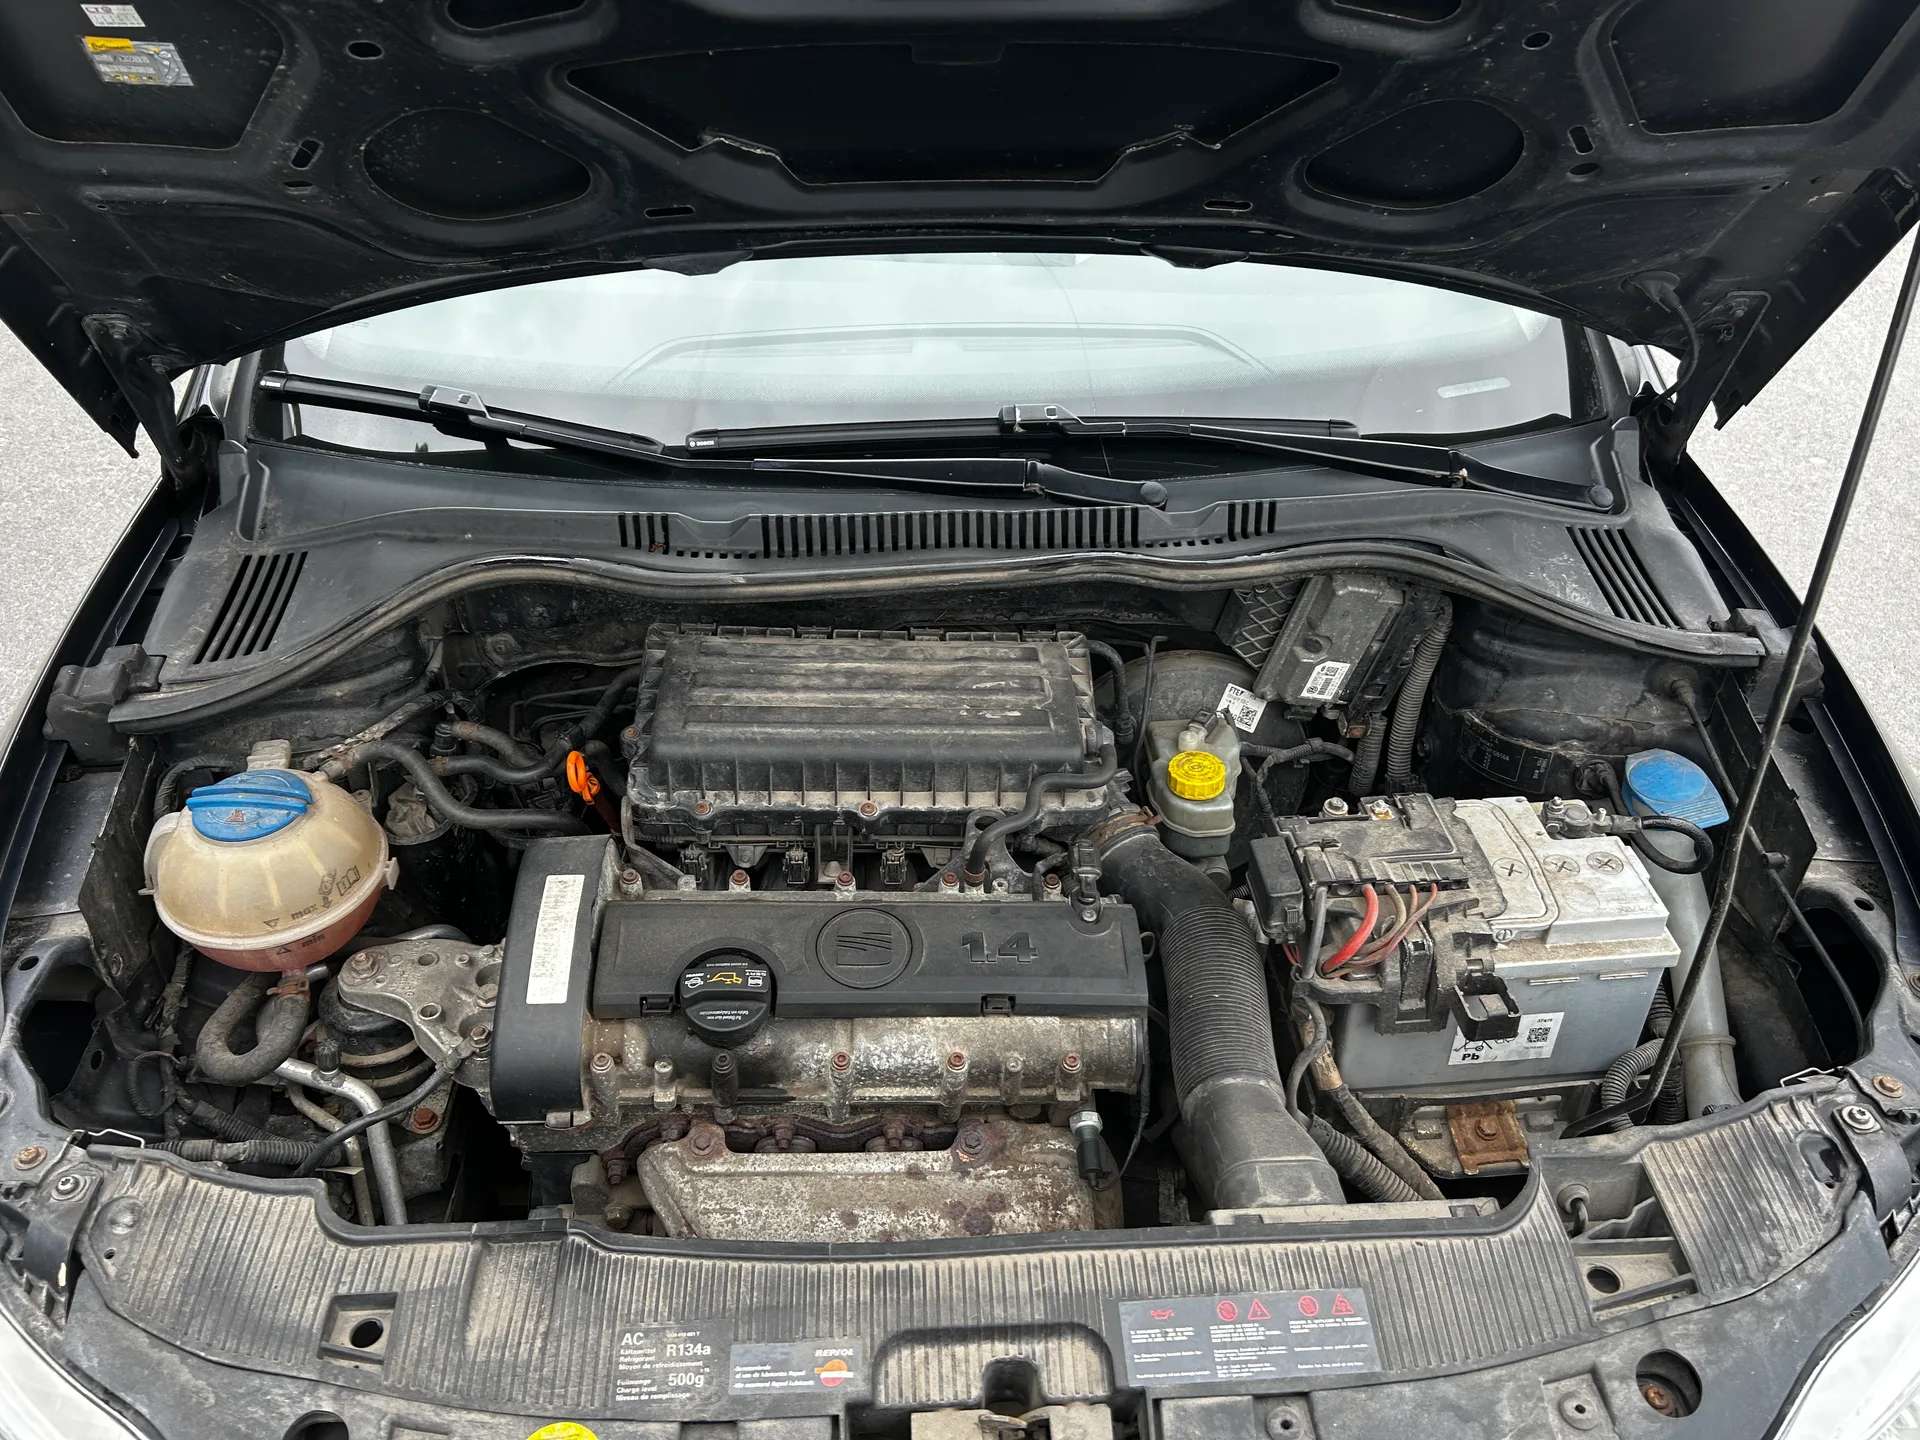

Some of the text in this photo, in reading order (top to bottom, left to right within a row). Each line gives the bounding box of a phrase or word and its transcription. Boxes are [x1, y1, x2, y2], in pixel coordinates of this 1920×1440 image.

[291, 903, 318, 920] max
[302, 934, 325, 947] min
[961, 931, 1039, 964] 1.4
[621, 1332, 644, 1346] AC
[666, 1343, 711, 1357] R134a
[814, 1348, 854, 1357] REPSOL
[667, 1372, 705, 1388] 500g
